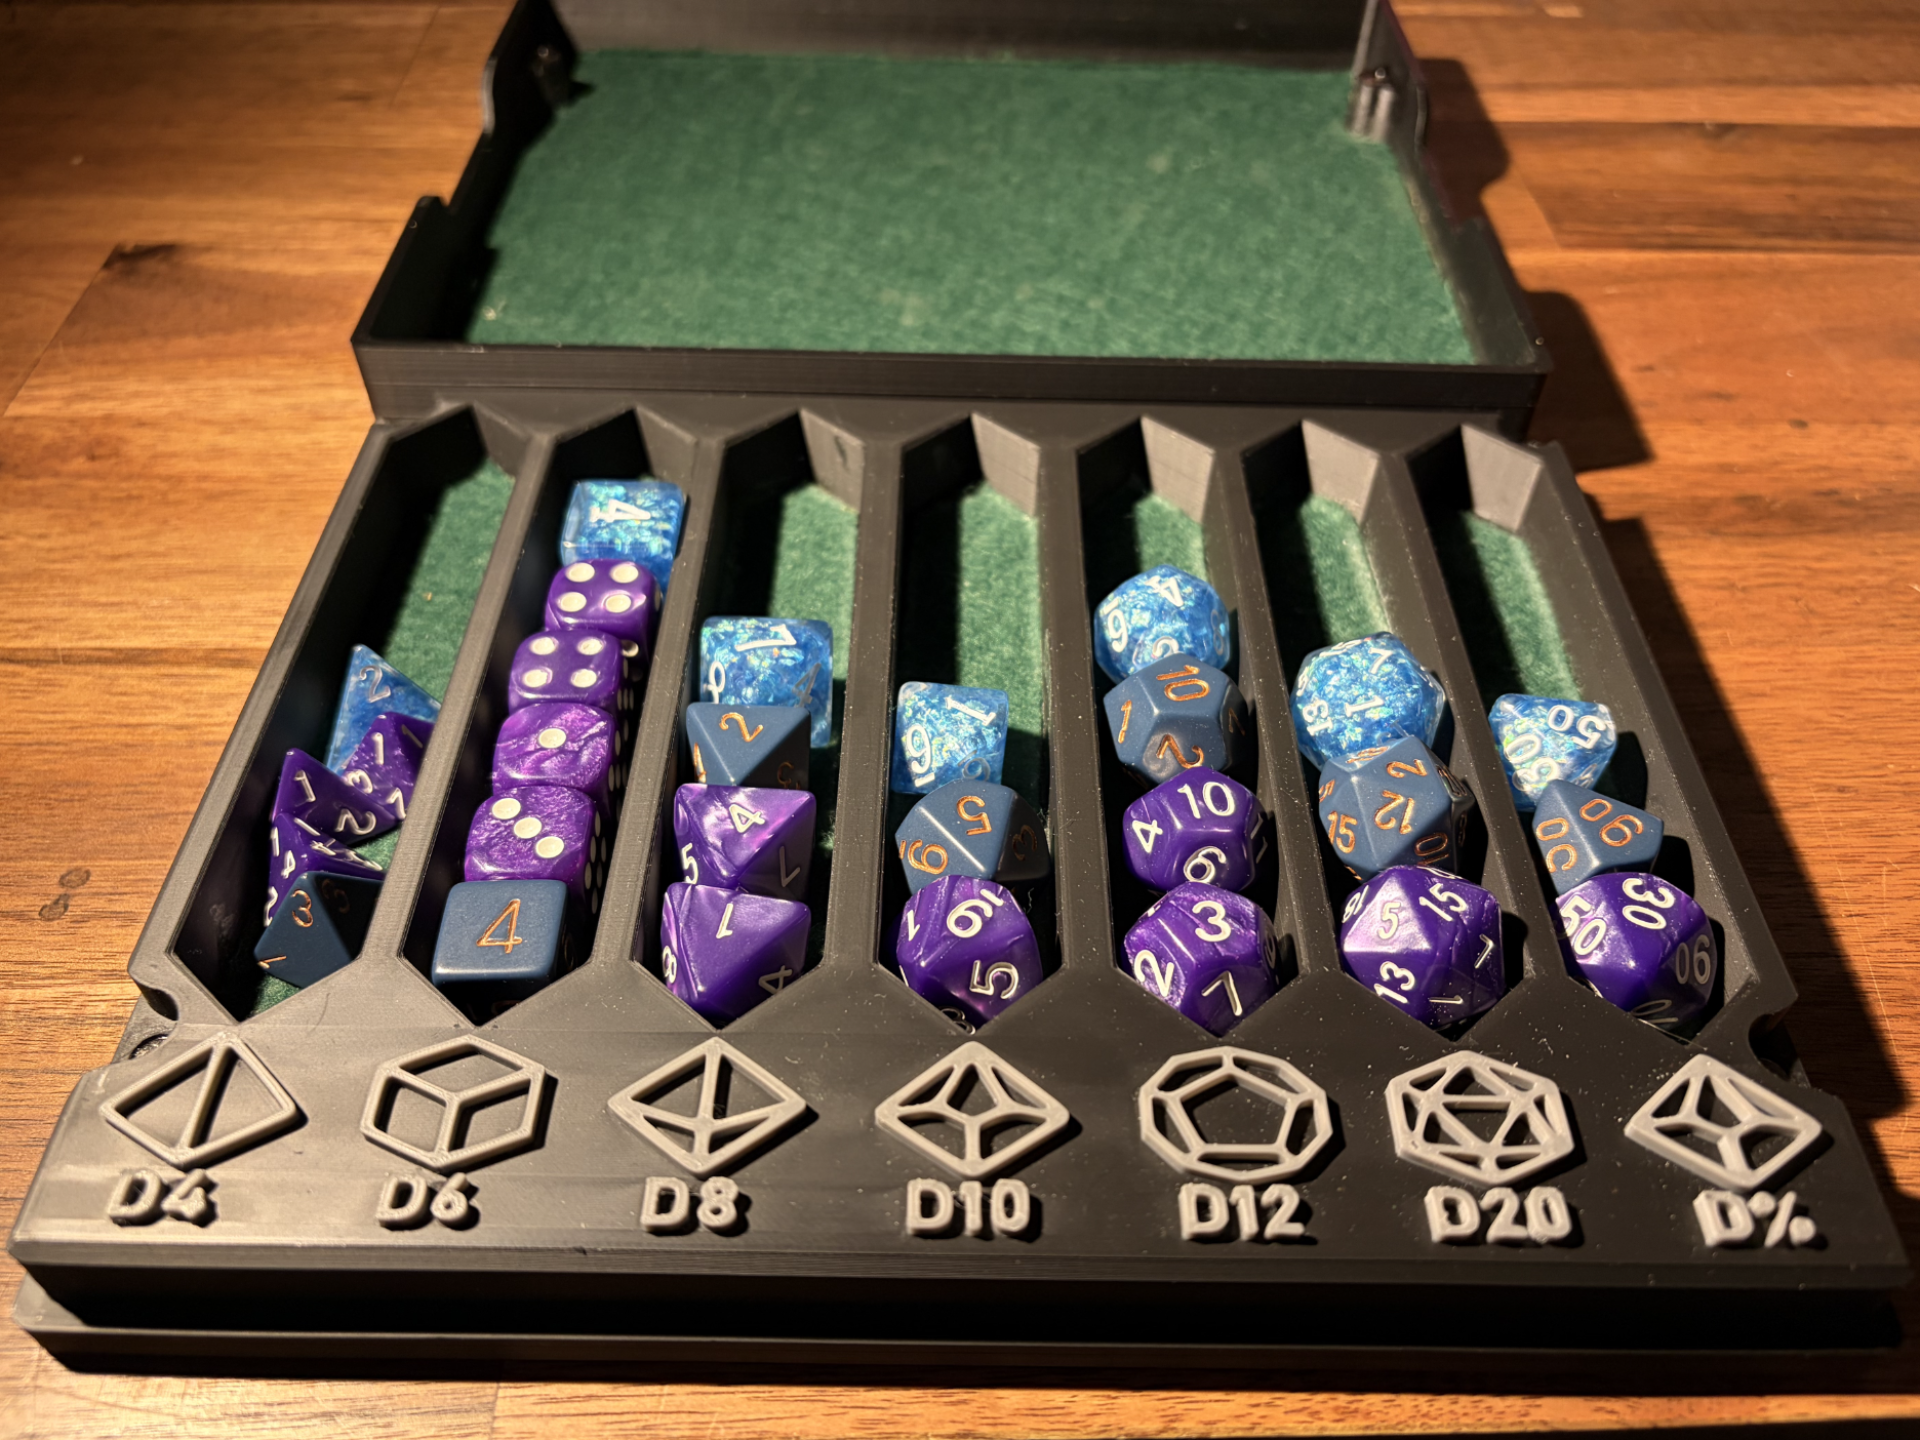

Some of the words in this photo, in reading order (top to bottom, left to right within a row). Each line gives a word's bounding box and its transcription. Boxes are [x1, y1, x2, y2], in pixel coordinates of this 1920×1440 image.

[588, 498, 651, 523] 4
[1368, 647, 1395, 675] 7
[359, 664, 392, 704] 2
[1156, 664, 1210, 702] 10
[944, 694, 997, 727] 1
[1343, 695, 1385, 717] 1
[718, 711, 764, 743] 2
[1547, 704, 1607, 750] 50
[371, 731, 385, 766] 1
[1155, 733, 1205, 769] 2
[1386, 758, 1429, 779] 2
[728, 803, 766, 834] 4
[956, 795, 993, 837] 5
[1176, 781, 1236, 819] 10
[1374, 789, 1416, 835] 12
[269, 826, 280, 857] 1
[333, 808, 377, 836] 2
[1131, 819, 1163, 854] 4
[1327, 810, 1358, 854] 15
[280, 849, 297, 879] 4
[681, 842, 699, 885] 5
[290, 889, 314, 928] 3
[716, 902, 735, 940] 1
[1192, 900, 1232, 943] 3
[1376, 902, 1401, 941] 5
[1418, 882, 1468, 923] 15
[1621, 877, 1677, 931] 30
[475, 898, 524, 954] 4
[1555, 894, 1608, 956] 50
[662, 944, 679, 984] 8
[757, 965, 794, 995] 4
[968, 959, 1020, 1000] 5
[1133, 949, 1176, 998] 2
[1373, 960, 1416, 1005] 13
[1200, 970, 1244, 1017] 7
[105, 1167, 207, 1220] D4
[376, 1171, 468, 1221] D6
[640, 1175, 739, 1228] D8
[906, 1177, 1031, 1236] D10
[1178, 1182, 1305, 1241] D12
[1424, 1185, 1572, 1244] D20
[1692, 1190, 1817, 1248] D%
